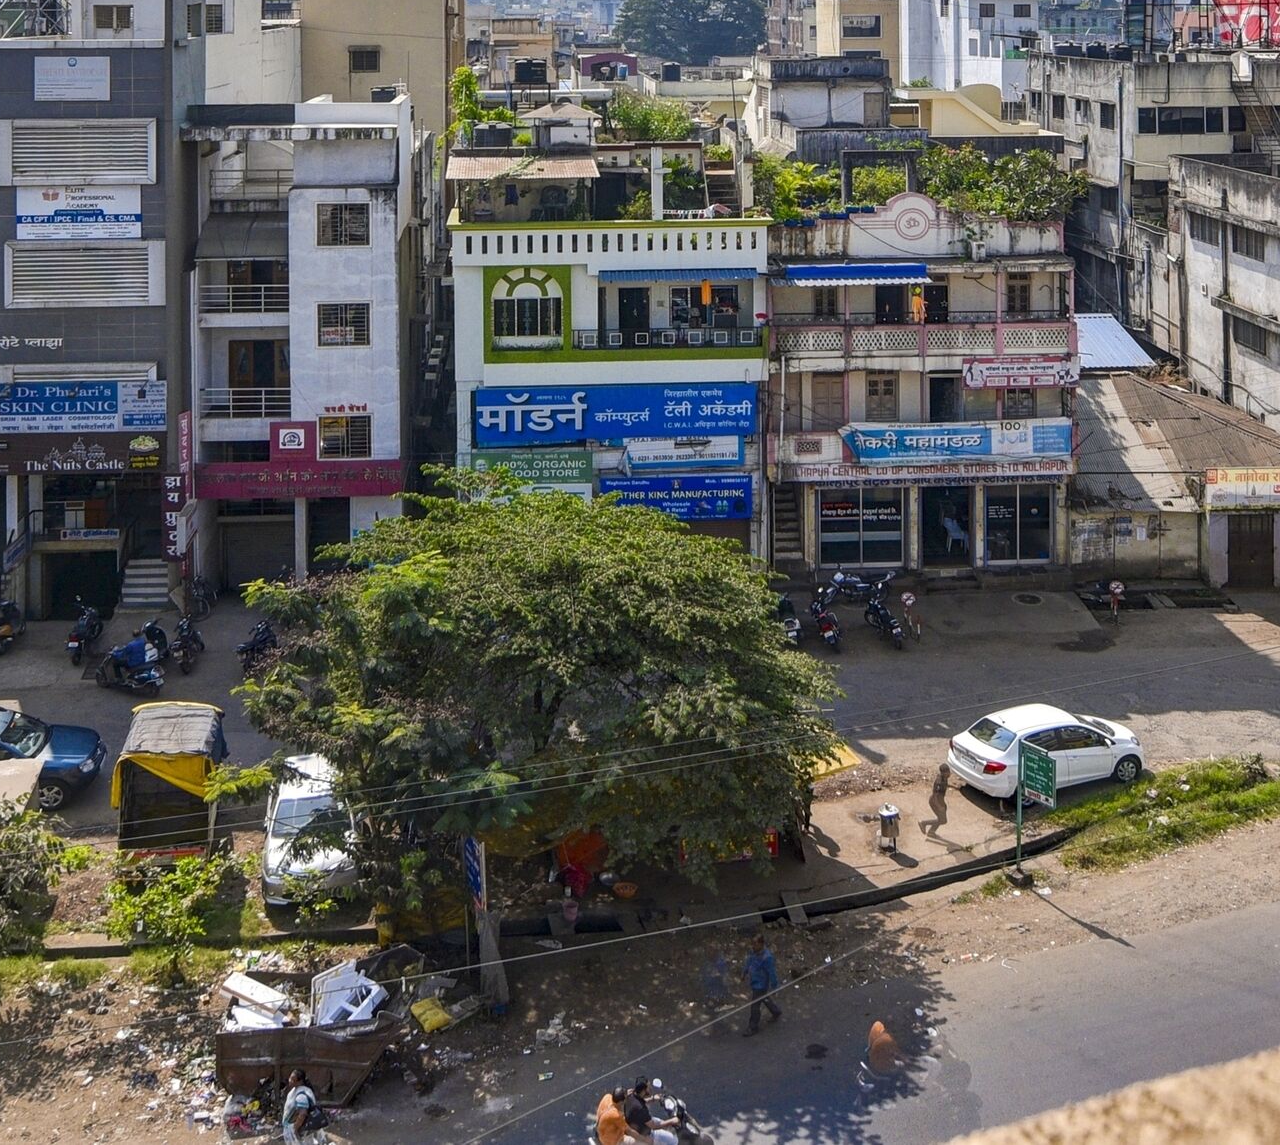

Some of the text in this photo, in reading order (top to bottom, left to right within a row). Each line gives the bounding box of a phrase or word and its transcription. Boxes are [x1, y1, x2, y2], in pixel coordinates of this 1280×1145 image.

[64, 194, 115, 202] PROFESSIONAL
[21, 215, 33, 224] CA
[33, 215, 49, 223] CPT
[53, 215, 72, 223] IPCC
[77, 215, 97, 223] Final
[97, 215, 104, 223] &
[118, 214, 136, 222] CMA
[0, 336, 64, 350] रोटे प्लाझा
[15, 386, 40, 398] Dr.
[700, 389, 723, 399] एकमेव
[0, 400, 117, 414] SKIN CLINIC
[476, 391, 651, 433] मॉडर्न कॉम्प्युटर्स
[663, 399, 753, 418] टॅली अकॅडमी
[903, 429, 984, 450] महामंडळ
[24, 460, 49, 472] The
[52, 458, 82, 472] Nuts
[85, 459, 125, 471] Castle
[495, 459, 587, 470] 100% ORGANIC
[832, 466, 873, 476] CENTRAL
[964, 464, 998, 474] STORES
[1022, 461, 1069, 472] KOLHAPUR
[542, 468, 581, 478] STORE
[617, 489, 745, 500] ATHER KING MANUFACTURING
